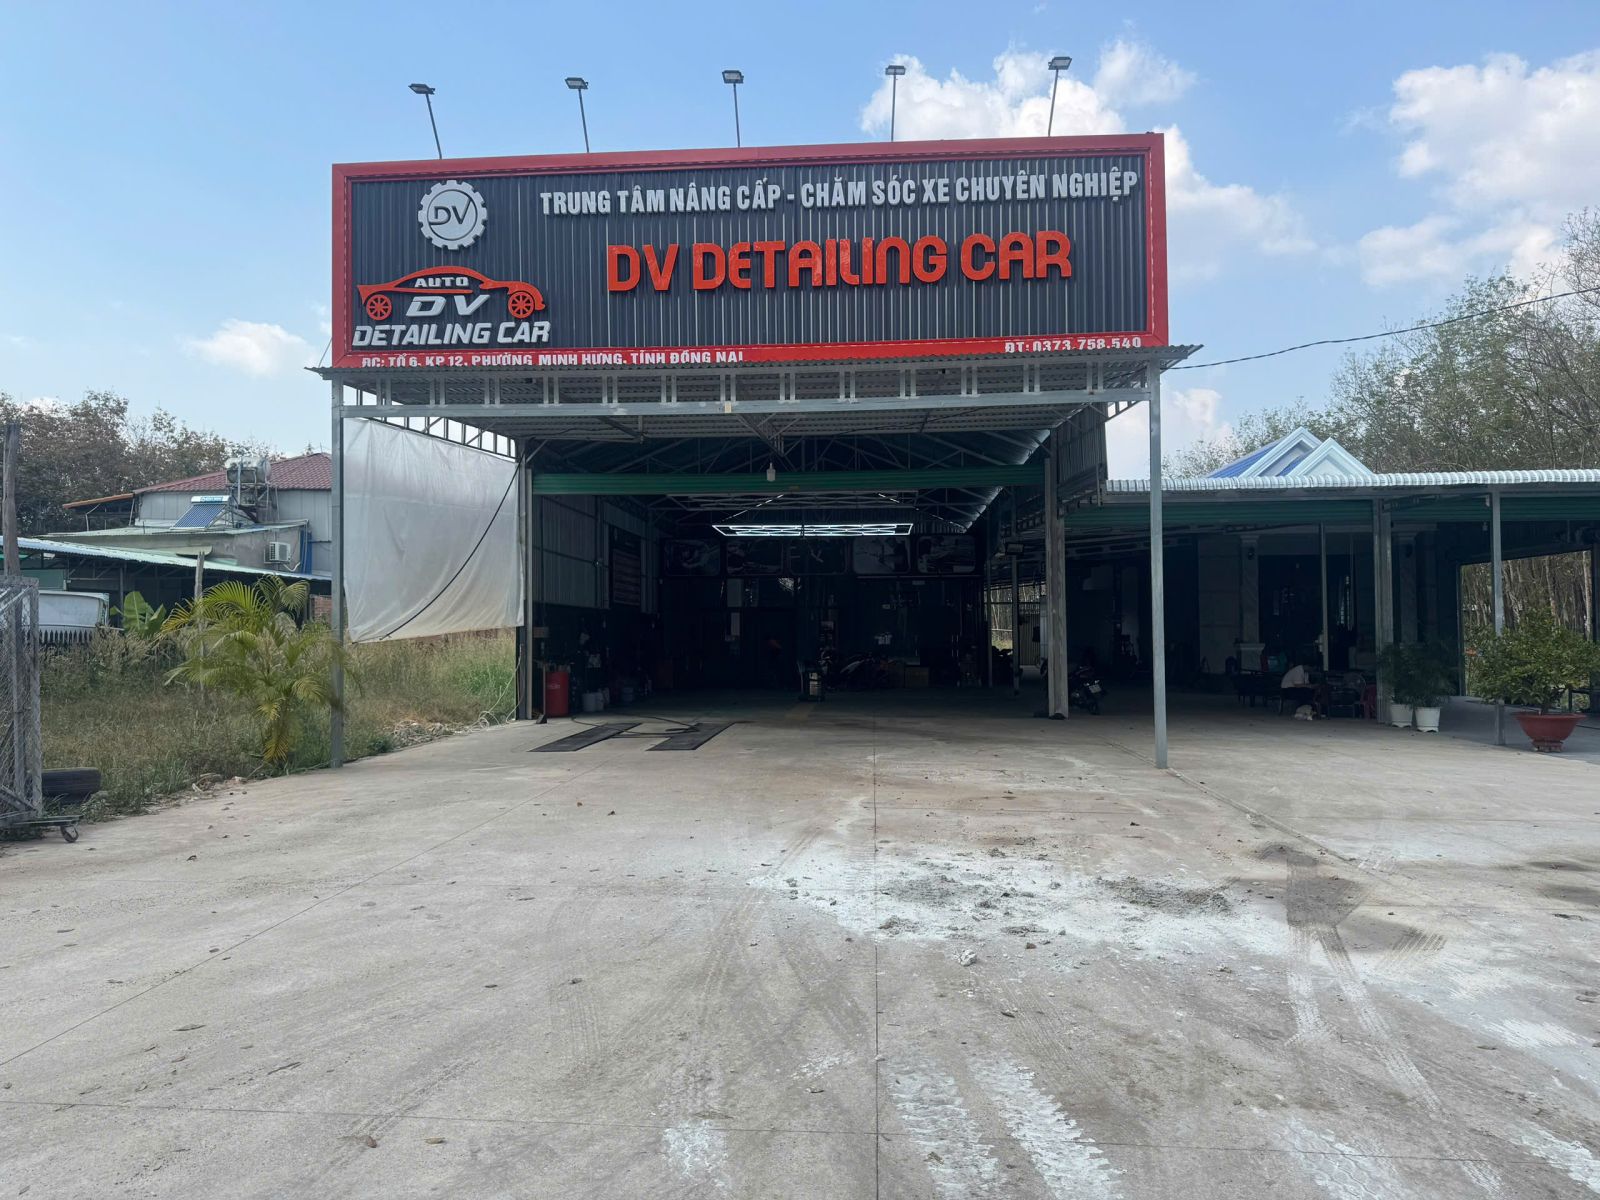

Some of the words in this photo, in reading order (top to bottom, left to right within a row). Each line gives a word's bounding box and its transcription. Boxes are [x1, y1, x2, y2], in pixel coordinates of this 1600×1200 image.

[540, 191, 611, 214] TRUNG
[617, 185, 665, 213] TÂM
[670, 182, 731, 211] NÂNG
[736, 177, 781, 209] CẤP
[801, 177, 866, 208] CHĂM
[872, 175, 916, 205] SÓC
[922, 178, 949, 203] XE
[955, 170, 1046, 202] CHUYÊN
[1052, 166, 1138, 201] NGHIỆP
[431, 197, 472, 225] DV
[608, 243, 679, 292] DV
[693, 235, 948, 291] DETAILING
[961, 230, 1072, 282] CAR
[414, 277, 469, 288] AUTO
[406, 294, 490, 317] DV
[352, 322, 492, 347] DETAILING
[497, 320, 551, 344] CAR
[425, 356, 445, 367] KP
[538, 353, 578, 366] MINH
